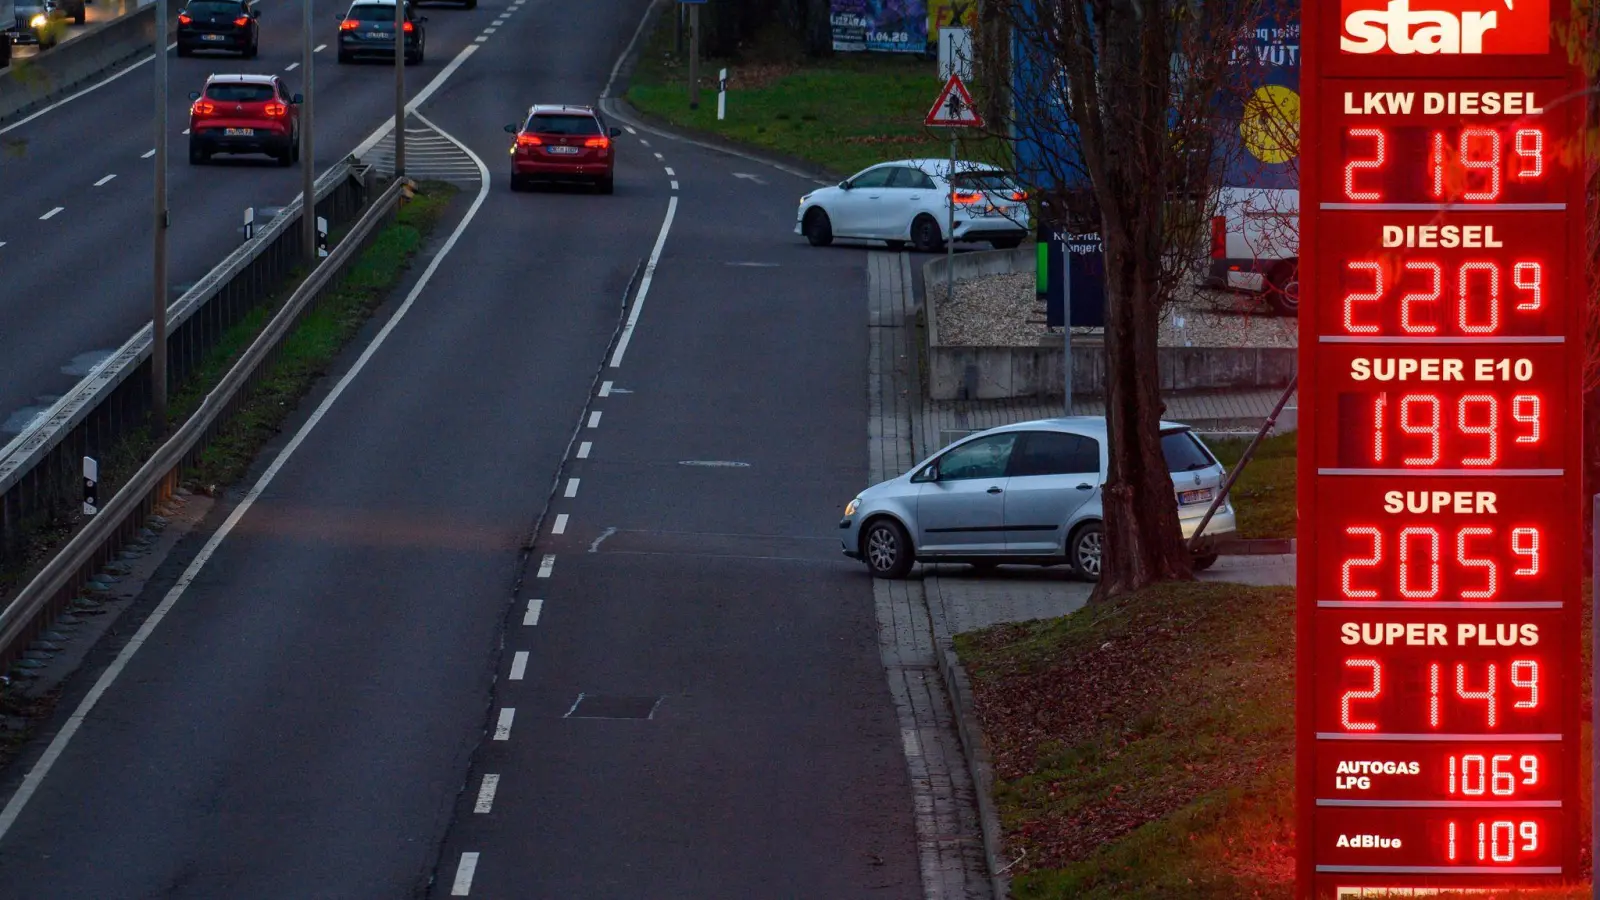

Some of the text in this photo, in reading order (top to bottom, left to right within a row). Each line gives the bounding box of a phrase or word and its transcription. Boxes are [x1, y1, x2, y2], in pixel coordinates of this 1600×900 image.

[1340, 0, 1497, 54] star
[1344, 92, 1544, 115] LKW DIESEL
[1382, 225, 1503, 248] DIESEL
[1350, 357, 1533, 381] SUPER E10
[1383, 490, 1498, 514] SUPER
[1340, 622, 1539, 646] SUPER PLUS
[1336, 760, 1421, 775] AUTOGAS
[1335, 776, 1371, 790] LPG
[1336, 834, 1402, 849] AdBlue
